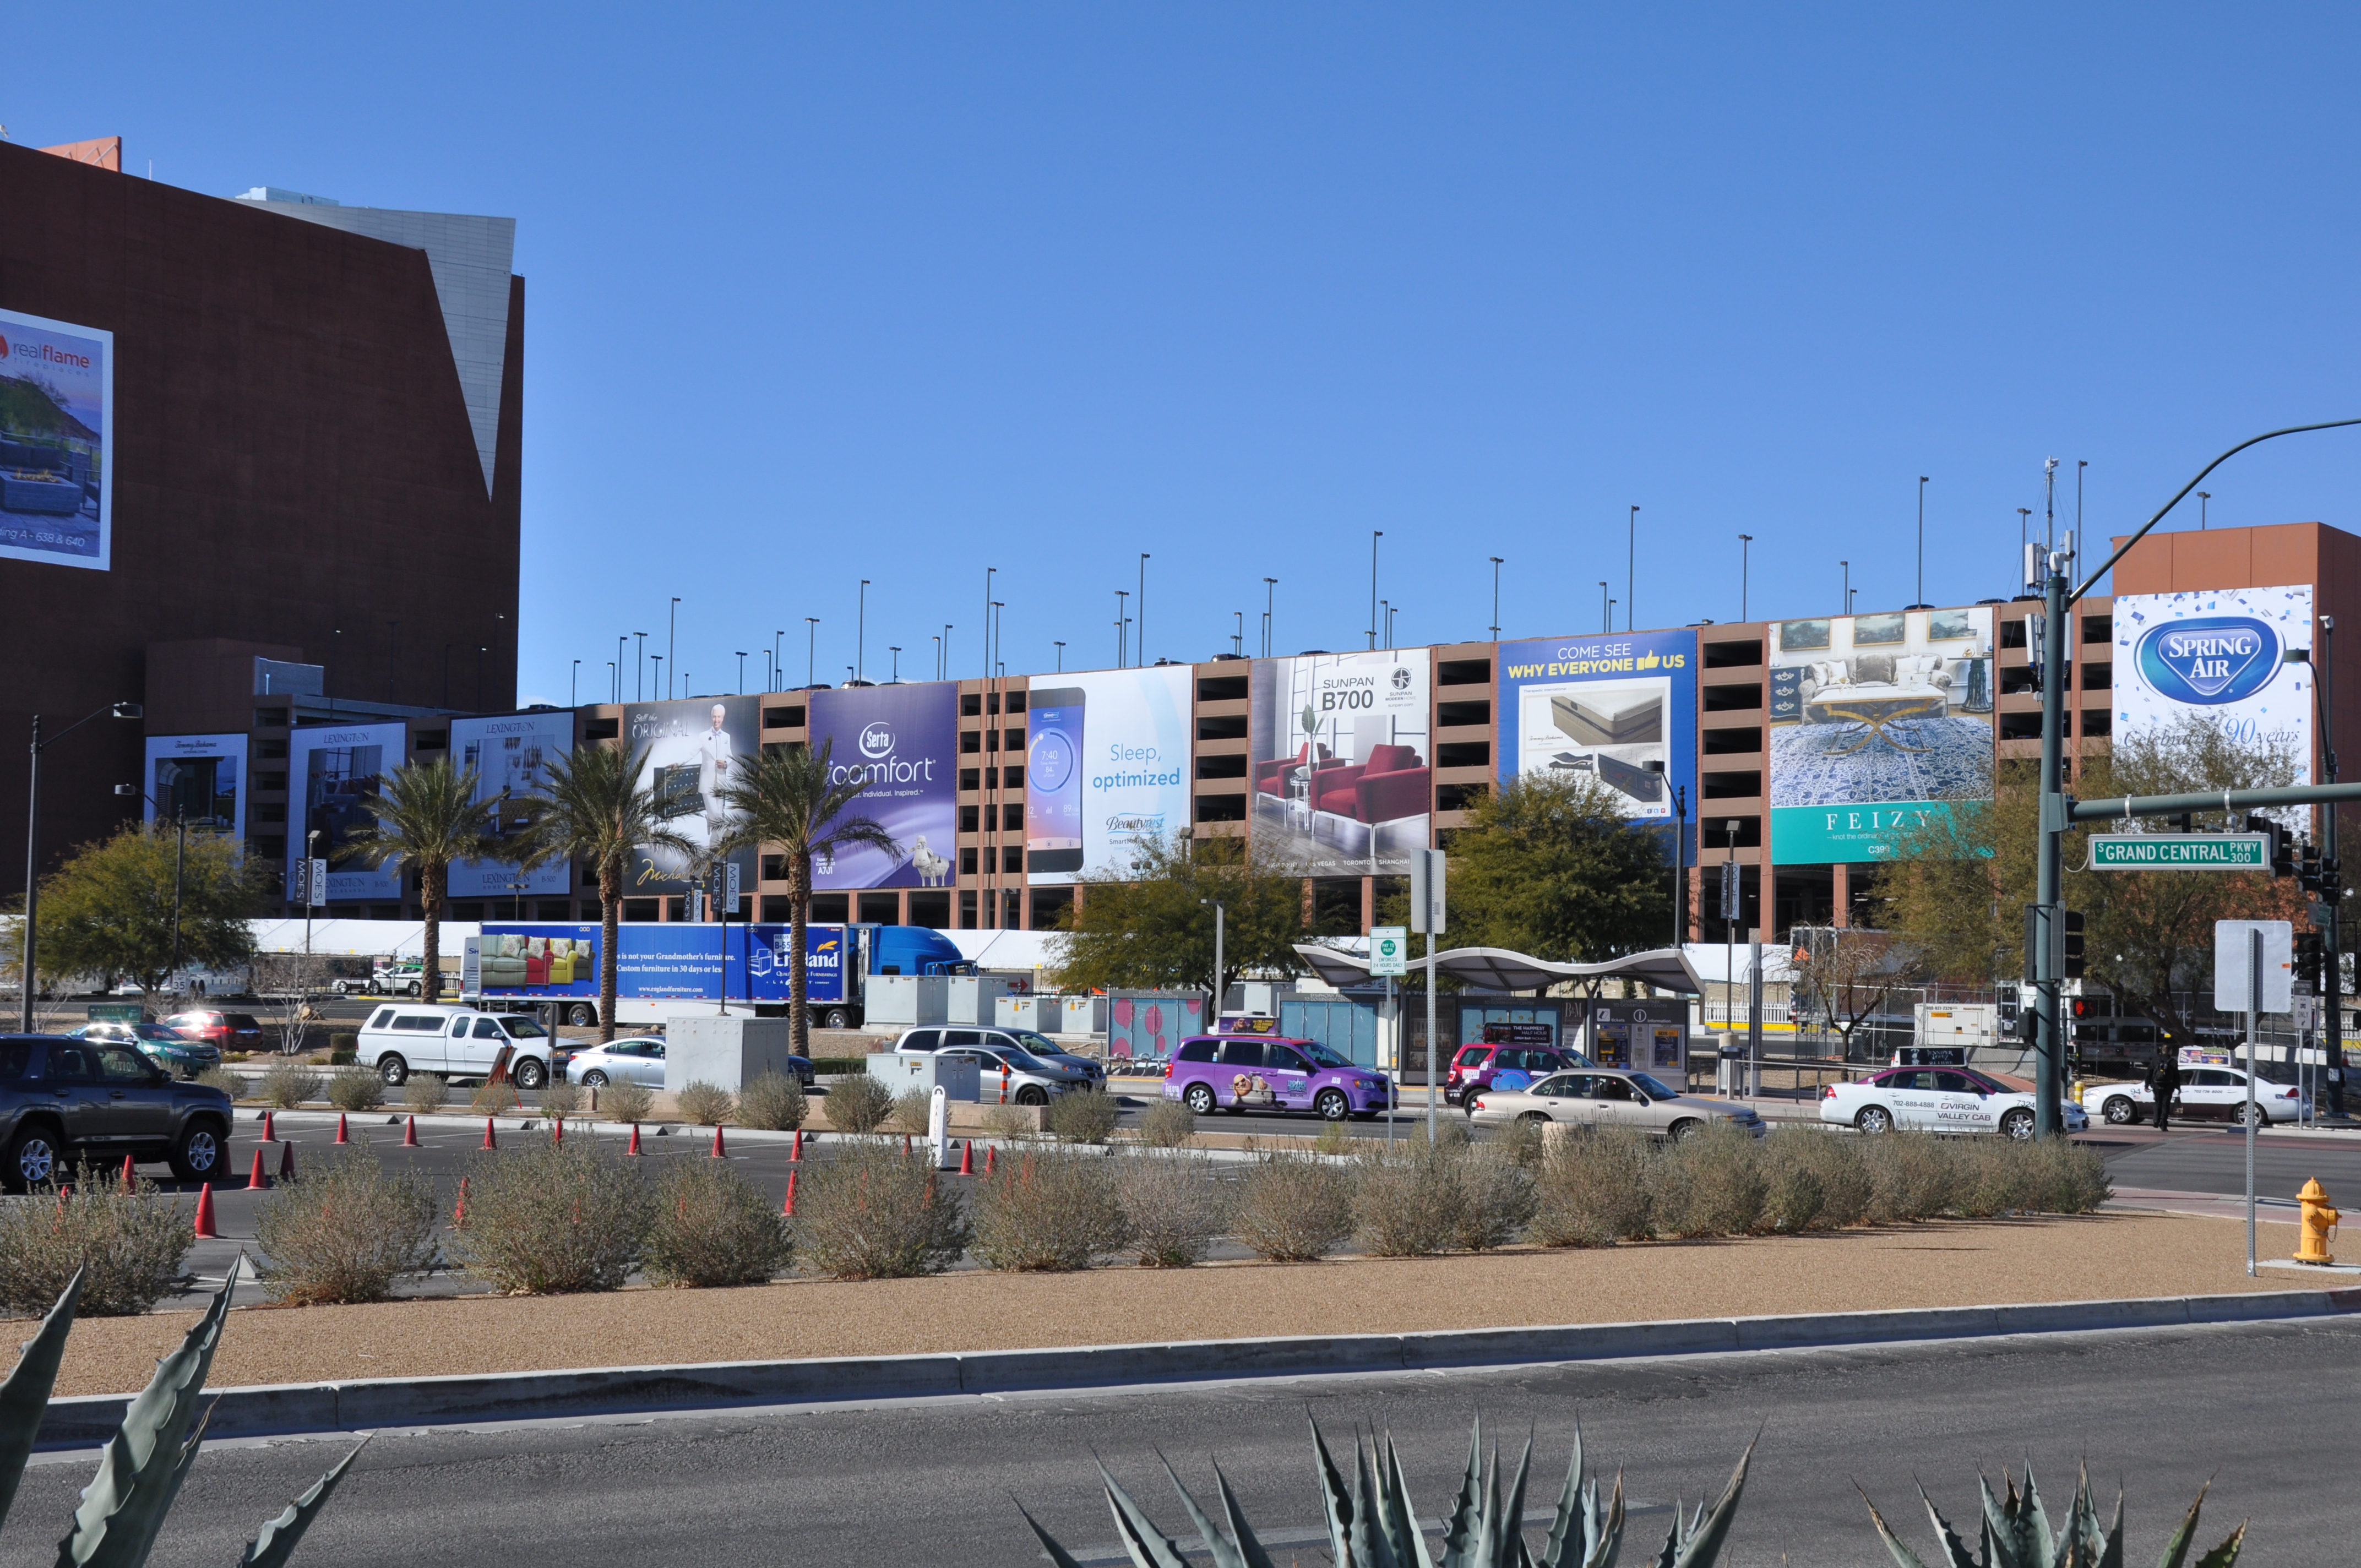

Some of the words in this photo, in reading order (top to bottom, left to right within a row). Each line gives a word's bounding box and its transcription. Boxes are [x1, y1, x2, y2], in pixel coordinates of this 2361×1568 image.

[13, 343, 90, 368] realflame
[14, 358, 90, 377] fireplaces
[19, 530, 27, 538] A
[36, 532, 54, 543] 638
[56, 535, 63, 544] &
[66, 536, 85, 547] 640
[1558, 645, 1600, 660] COME
[1604, 643, 1631, 656] SEE
[2169, 636, 2252, 657] SPRING
[1508, 663, 1545, 678] WHY
[1548, 657, 1634, 676] EVERYONE
[1662, 654, 1685, 668] US
[2189, 657, 2229, 678] AIR
[1323, 677, 1374, 689] SUNPAN
[1323, 690, 1373, 711] B700
[487, 722, 535, 734] LEXINGTON
[632, 721, 689, 739] ORIGINAL
[2226, 717, 2256, 744] 90
[324, 732, 369, 744] LEXINGTON
[867, 731, 889, 748] Serta
[1042, 750, 1058, 760] 7:40
[1111, 743, 1161, 765] Sleep,
[826, 755, 933, 786] icomfort
[1093, 767, 1180, 793] optimized
[1106, 816, 1165, 831] Beautyrest
[1826, 810, 1930, 830] FEIZY
[2098, 843, 2104, 852] S
[2106, 845, 2156, 860] GRAND
[2159, 845, 2229, 860] CENTRAL
[2230, 842, 2258, 852] PKWY
[2231, 853, 2251, 863] 300
[297, 860, 306, 899] MOE'S
[818, 867, 833, 875] A701
[315, 861, 323, 899] MOE'S
[326, 877, 365, 888] EXINGTON
[774, 951, 839, 967] Enland
[688, 965, 703, 974] days
[173, 981, 185, 990] 35
[2017, 1099, 2036, 1108] 7324
[1938, 1112, 1970, 1120] VALLEY
